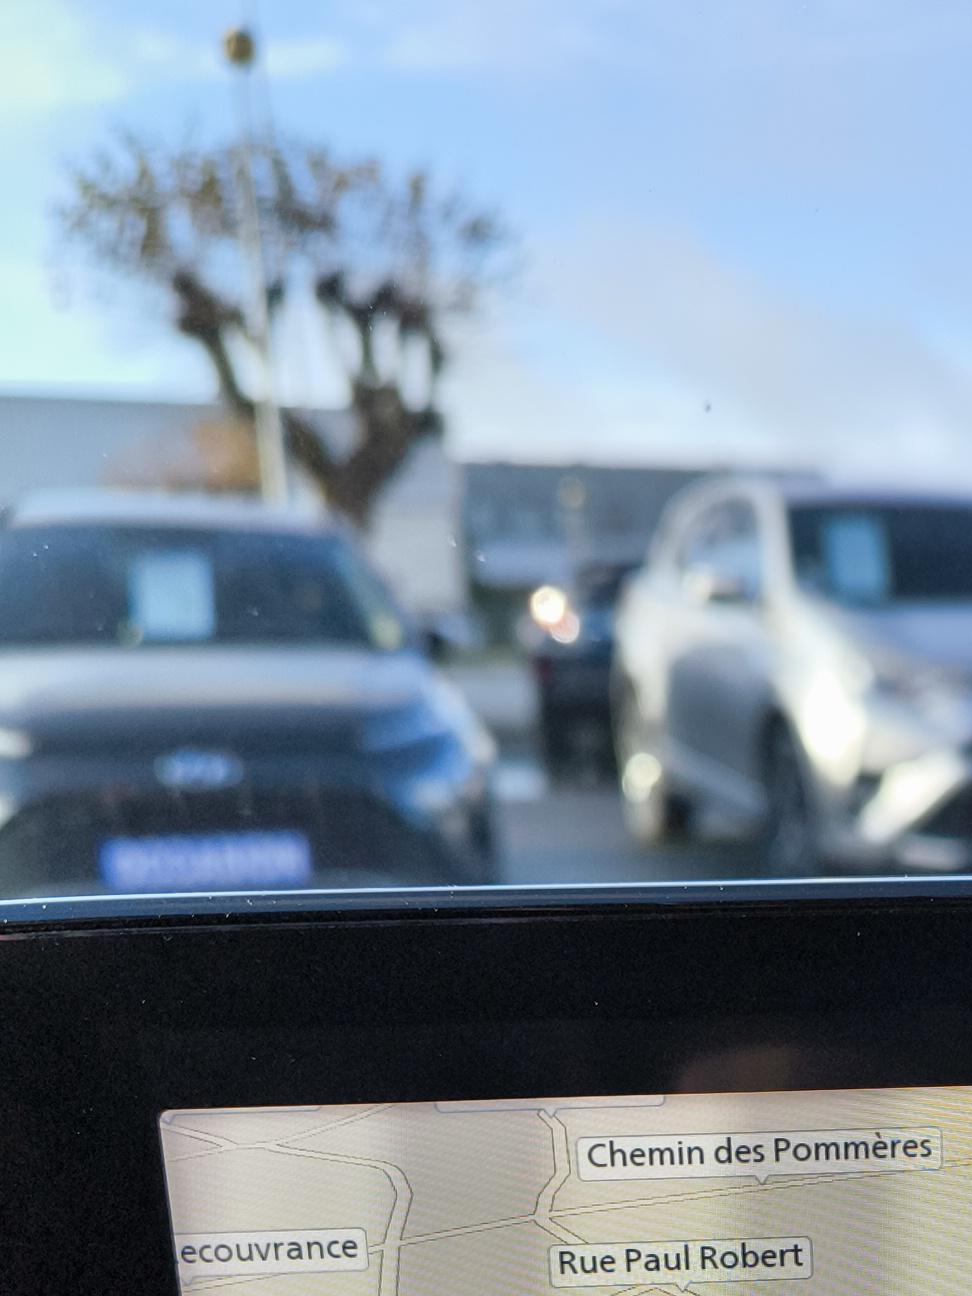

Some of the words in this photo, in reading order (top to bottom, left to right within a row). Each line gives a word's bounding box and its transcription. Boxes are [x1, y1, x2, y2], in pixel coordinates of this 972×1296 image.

[586, 1141, 706, 1169] Chemin
[714, 1136, 766, 1164] des
[773, 1131, 933, 1162] Pommères
[178, 1238, 359, 1264] ecouvrance
[558, 1250, 616, 1275] Rue
[624, 1243, 692, 1272] Paul
[700, 1241, 804, 1270] Robert
